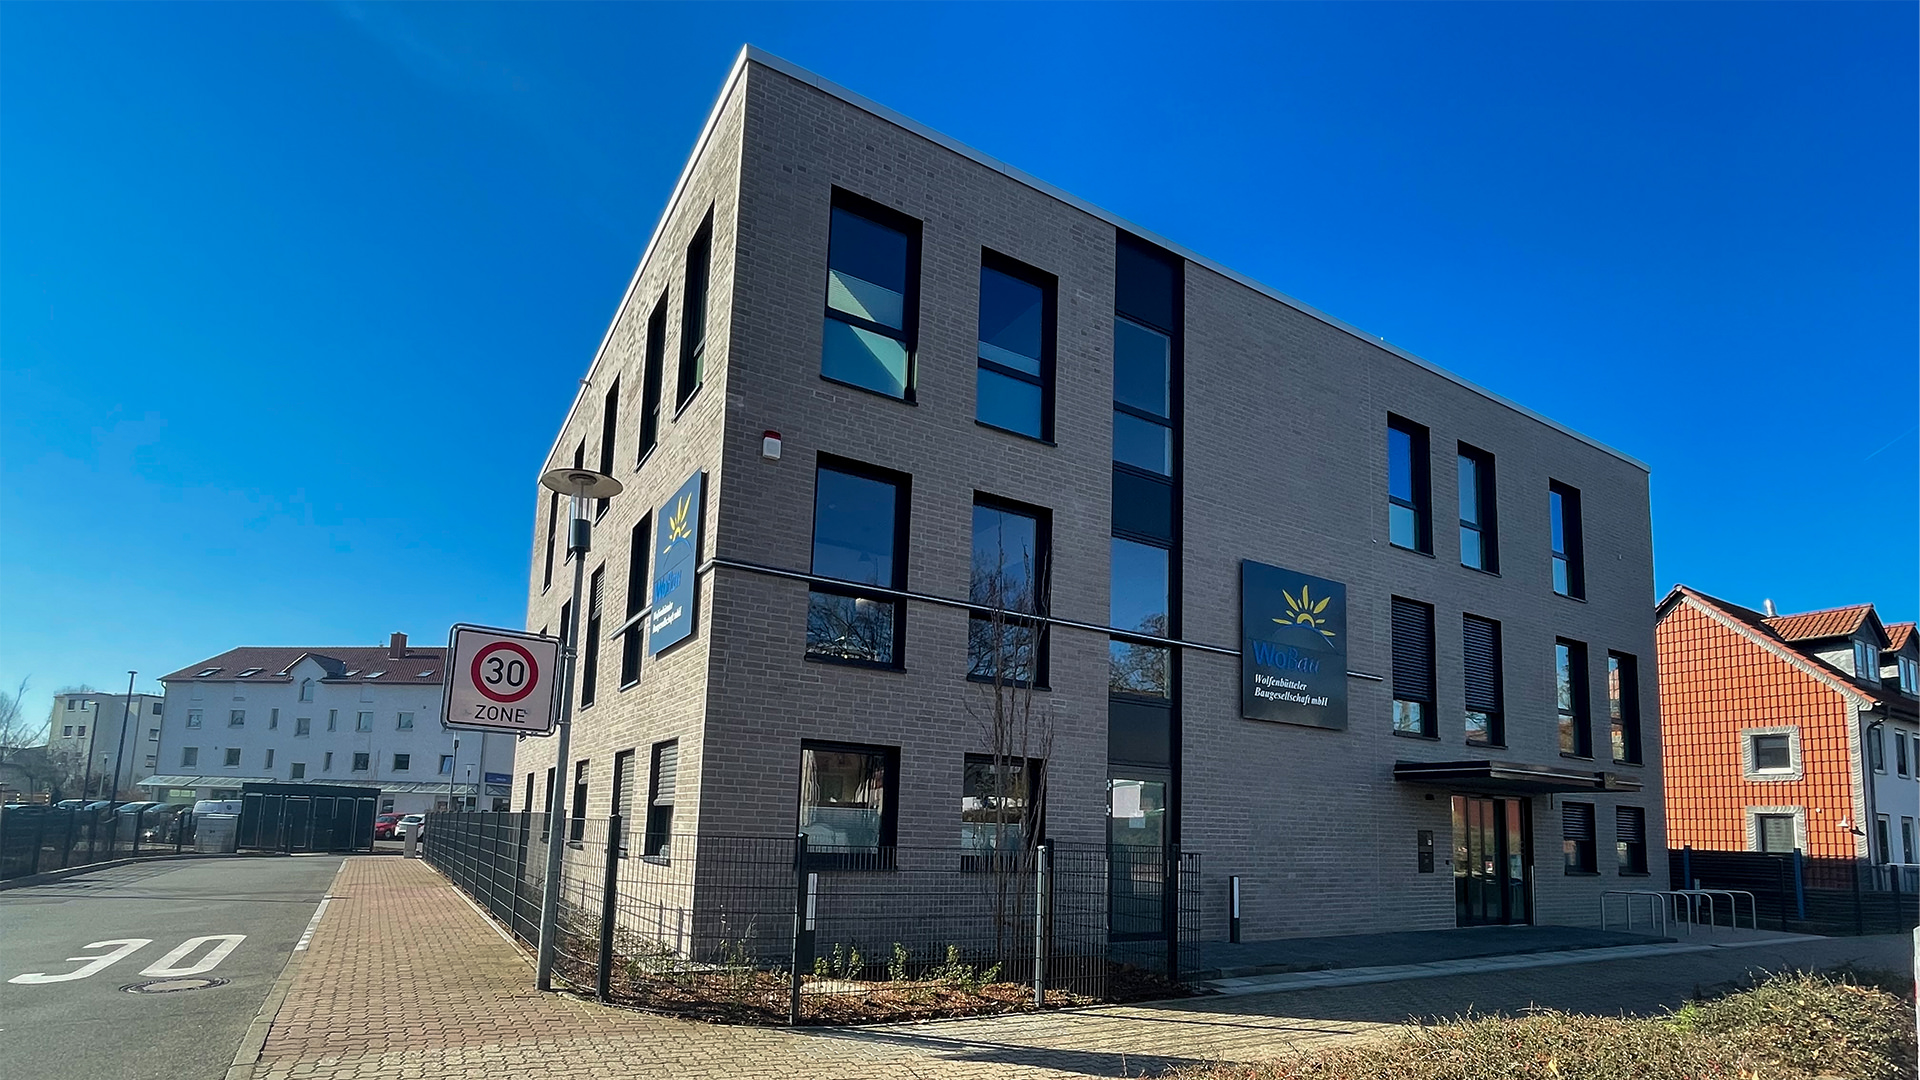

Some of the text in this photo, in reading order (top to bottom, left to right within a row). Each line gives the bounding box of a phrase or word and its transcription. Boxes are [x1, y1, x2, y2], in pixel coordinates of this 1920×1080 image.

[1253, 639, 1320, 674] WoBau
[485, 657, 525, 687] 30
[1255, 673, 1307, 691] Wolfenbütteler
[1254, 686, 1328, 707] Baugesellschaft mbH
[474, 704, 526, 723] ZONE
[8, 934, 248, 984] 30
